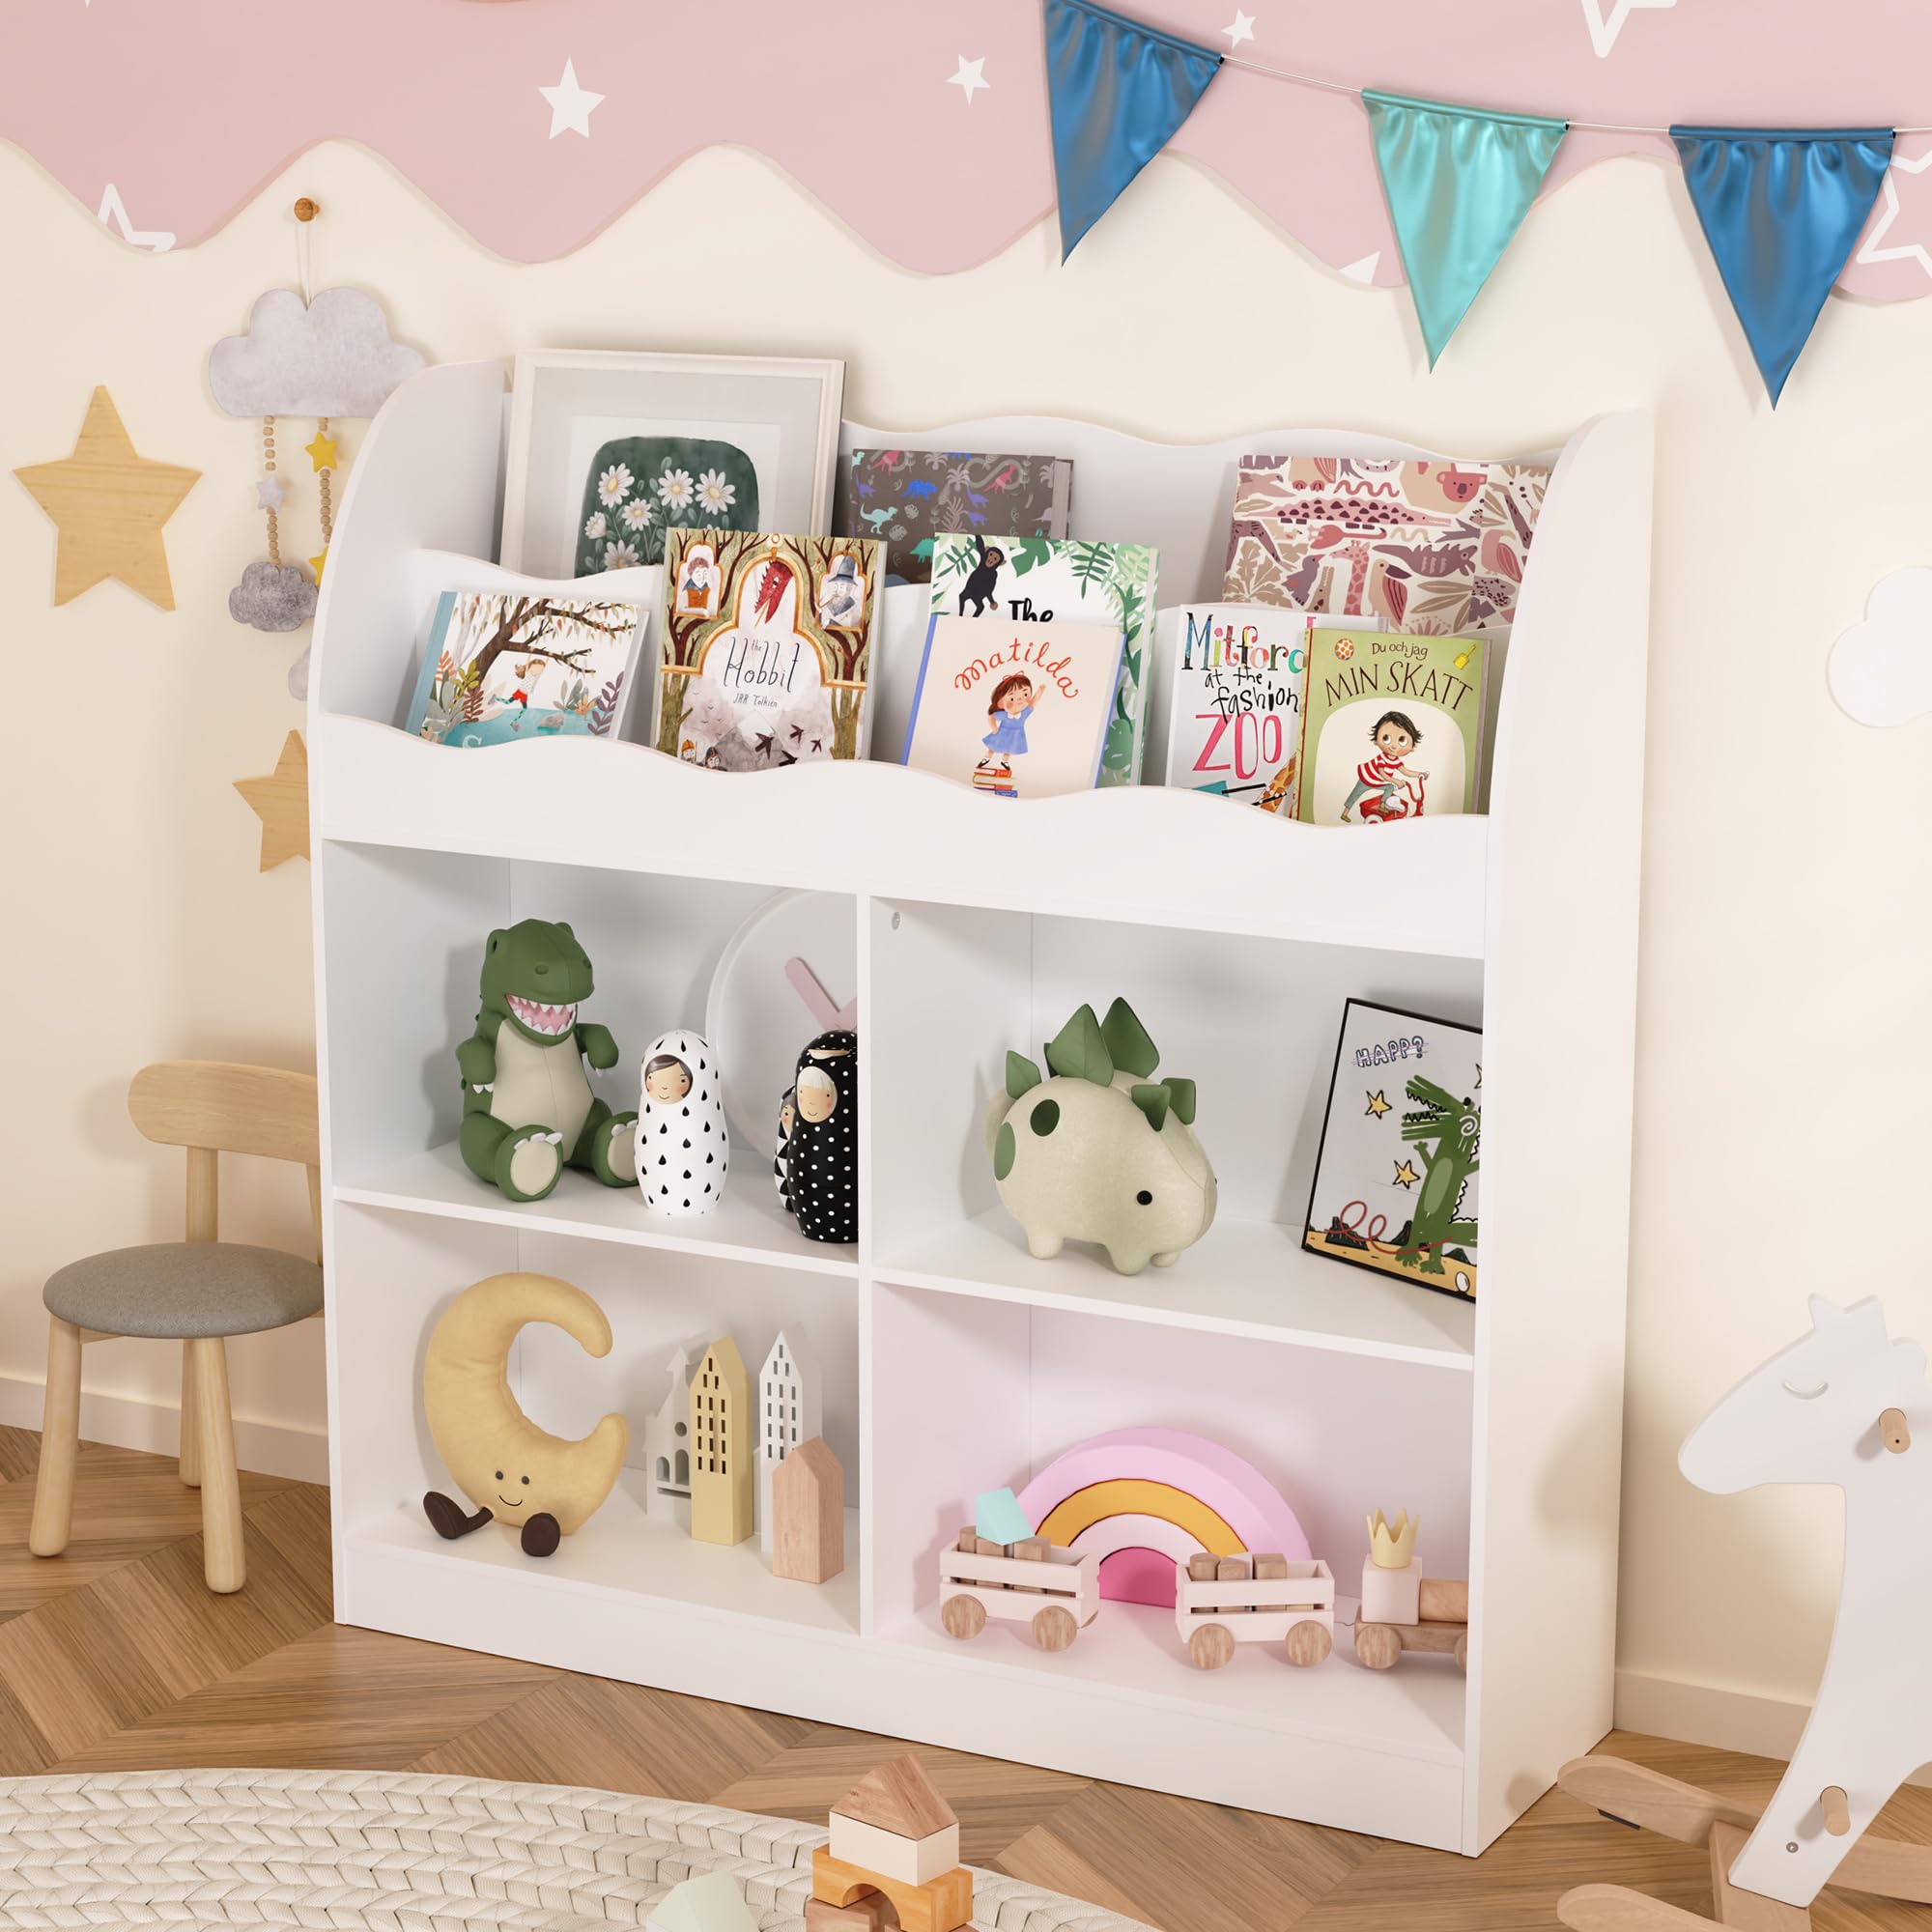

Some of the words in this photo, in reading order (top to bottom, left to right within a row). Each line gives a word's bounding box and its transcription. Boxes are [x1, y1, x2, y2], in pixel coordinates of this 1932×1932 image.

[1008, 597, 1054, 623] The
[751, 639, 762, 652] the
[1372, 642, 1386, 656] Du
[1389, 641, 1408, 653] och
[1405, 645, 1429, 662] jag
[723, 636, 801, 694] Hobbit
[954, 638, 1079, 699] Matilda
[1205, 669, 1223, 688] at
[1233, 668, 1263, 687] the
[1324, 664, 1378, 707] MIN
[1386, 661, 1474, 711] SKATT
[733, 693, 750, 704] JRR
[753, 695, 779, 708] Tolkien
[1210, 680, 1299, 724] fashion
